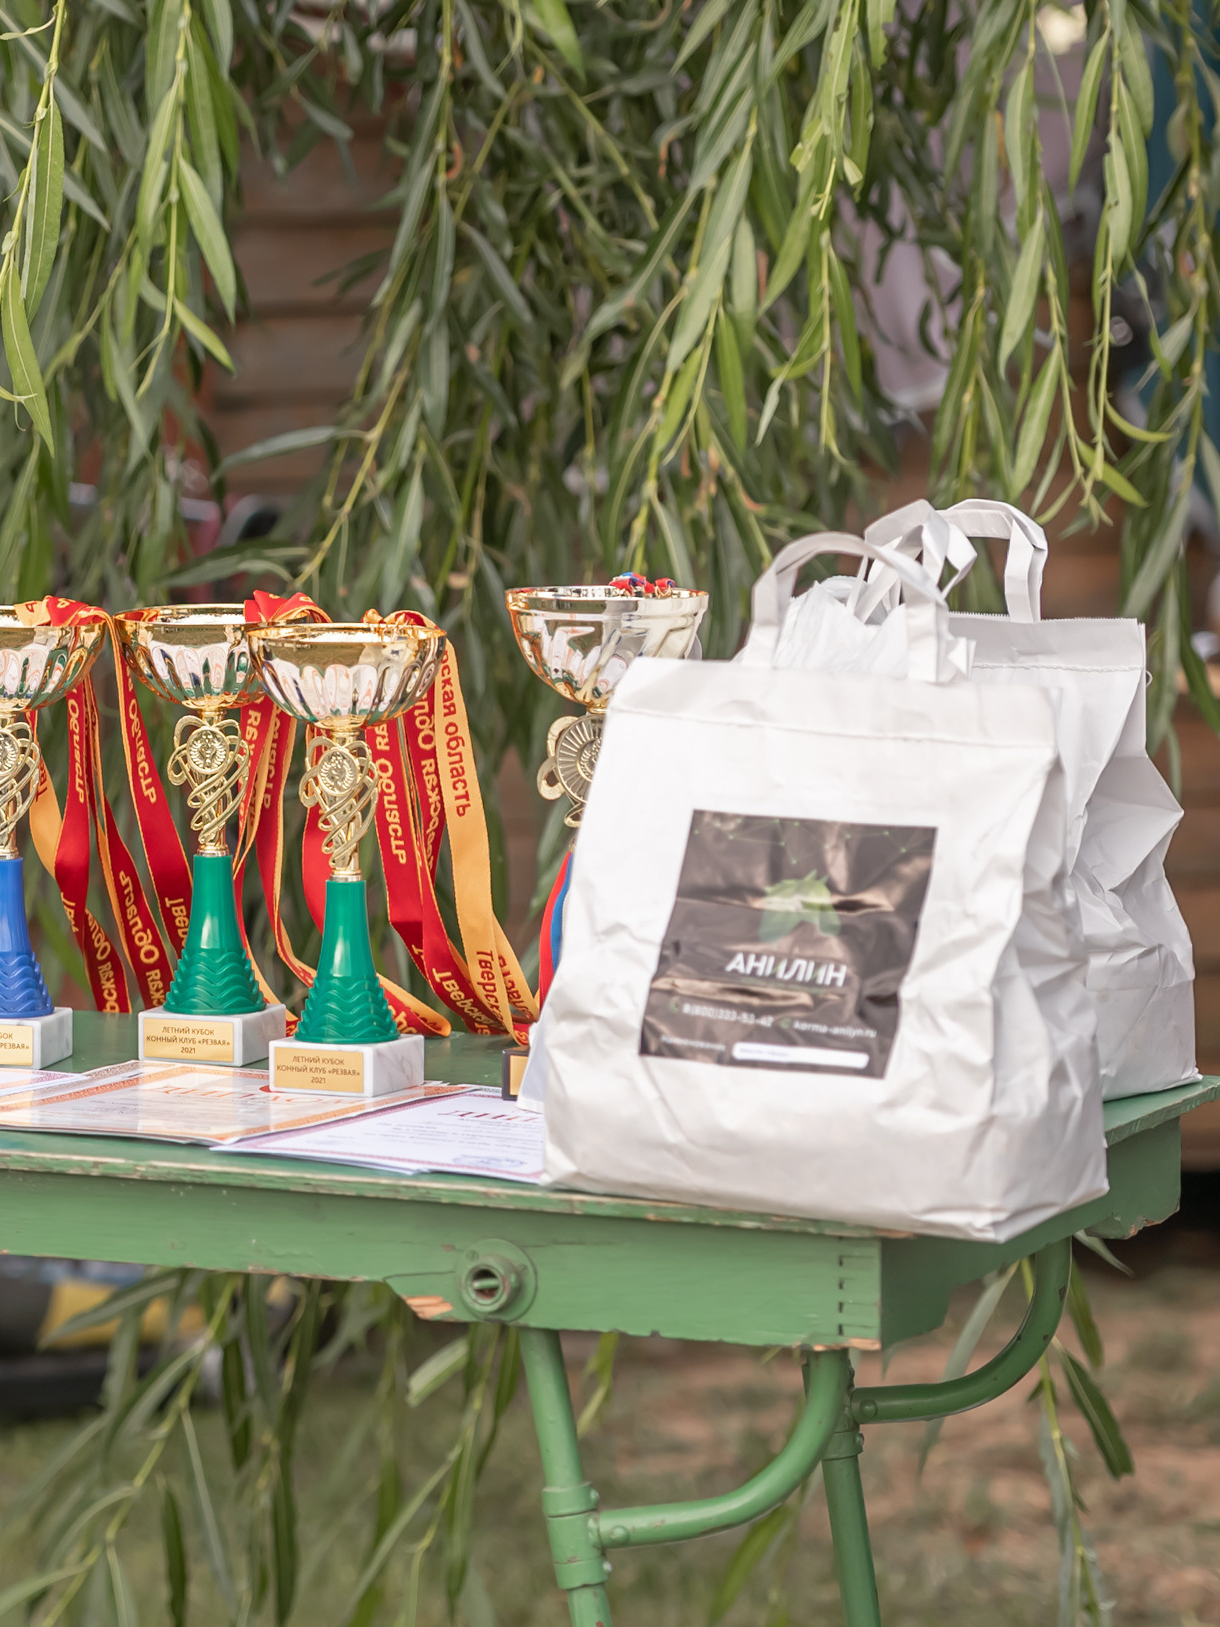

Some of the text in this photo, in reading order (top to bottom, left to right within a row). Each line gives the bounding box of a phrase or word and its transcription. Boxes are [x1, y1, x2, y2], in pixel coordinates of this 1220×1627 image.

[725, 952, 848, 988] АНИЛИН
[161, 1026, 215, 1036] ЛЕТНИЙ КУБОК
[146, 1035, 230, 1046] КОННЫЙ КЛУБ «РЕЗВАЯ»
[180, 1046, 196, 1054] 2021
[292, 1055, 345, 1065] ЛЕТНИЙ КУБОК
[276, 1064, 308, 1072] КОННЫЙ
[328, 1068, 360, 1076] «РЕЗВАЯ»
[310, 1076, 326, 1084] 2021
